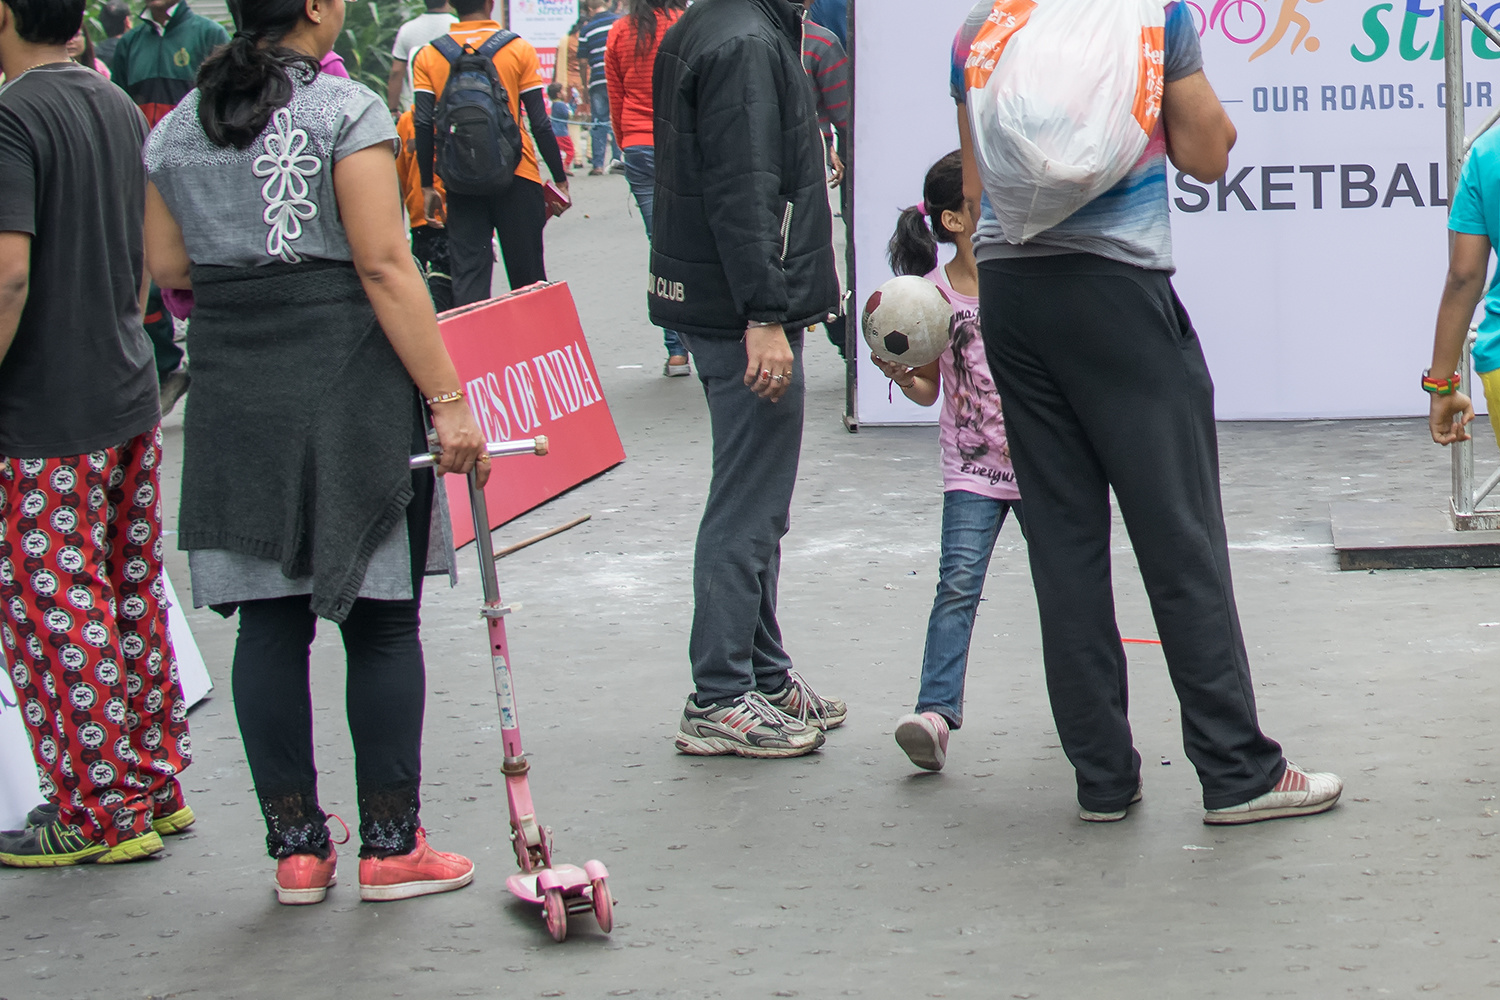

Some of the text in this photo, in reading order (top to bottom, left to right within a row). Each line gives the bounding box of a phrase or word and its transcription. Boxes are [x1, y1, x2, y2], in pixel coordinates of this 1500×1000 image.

[537, 5, 574, 16] streets
[1252, 85, 1309, 112] OUR
[1321, 83, 1424, 111] ROADS.
[656, 276, 686, 302] CLUB
[504, 361, 542, 434] OF
[532, 340, 603, 421] INDIA
